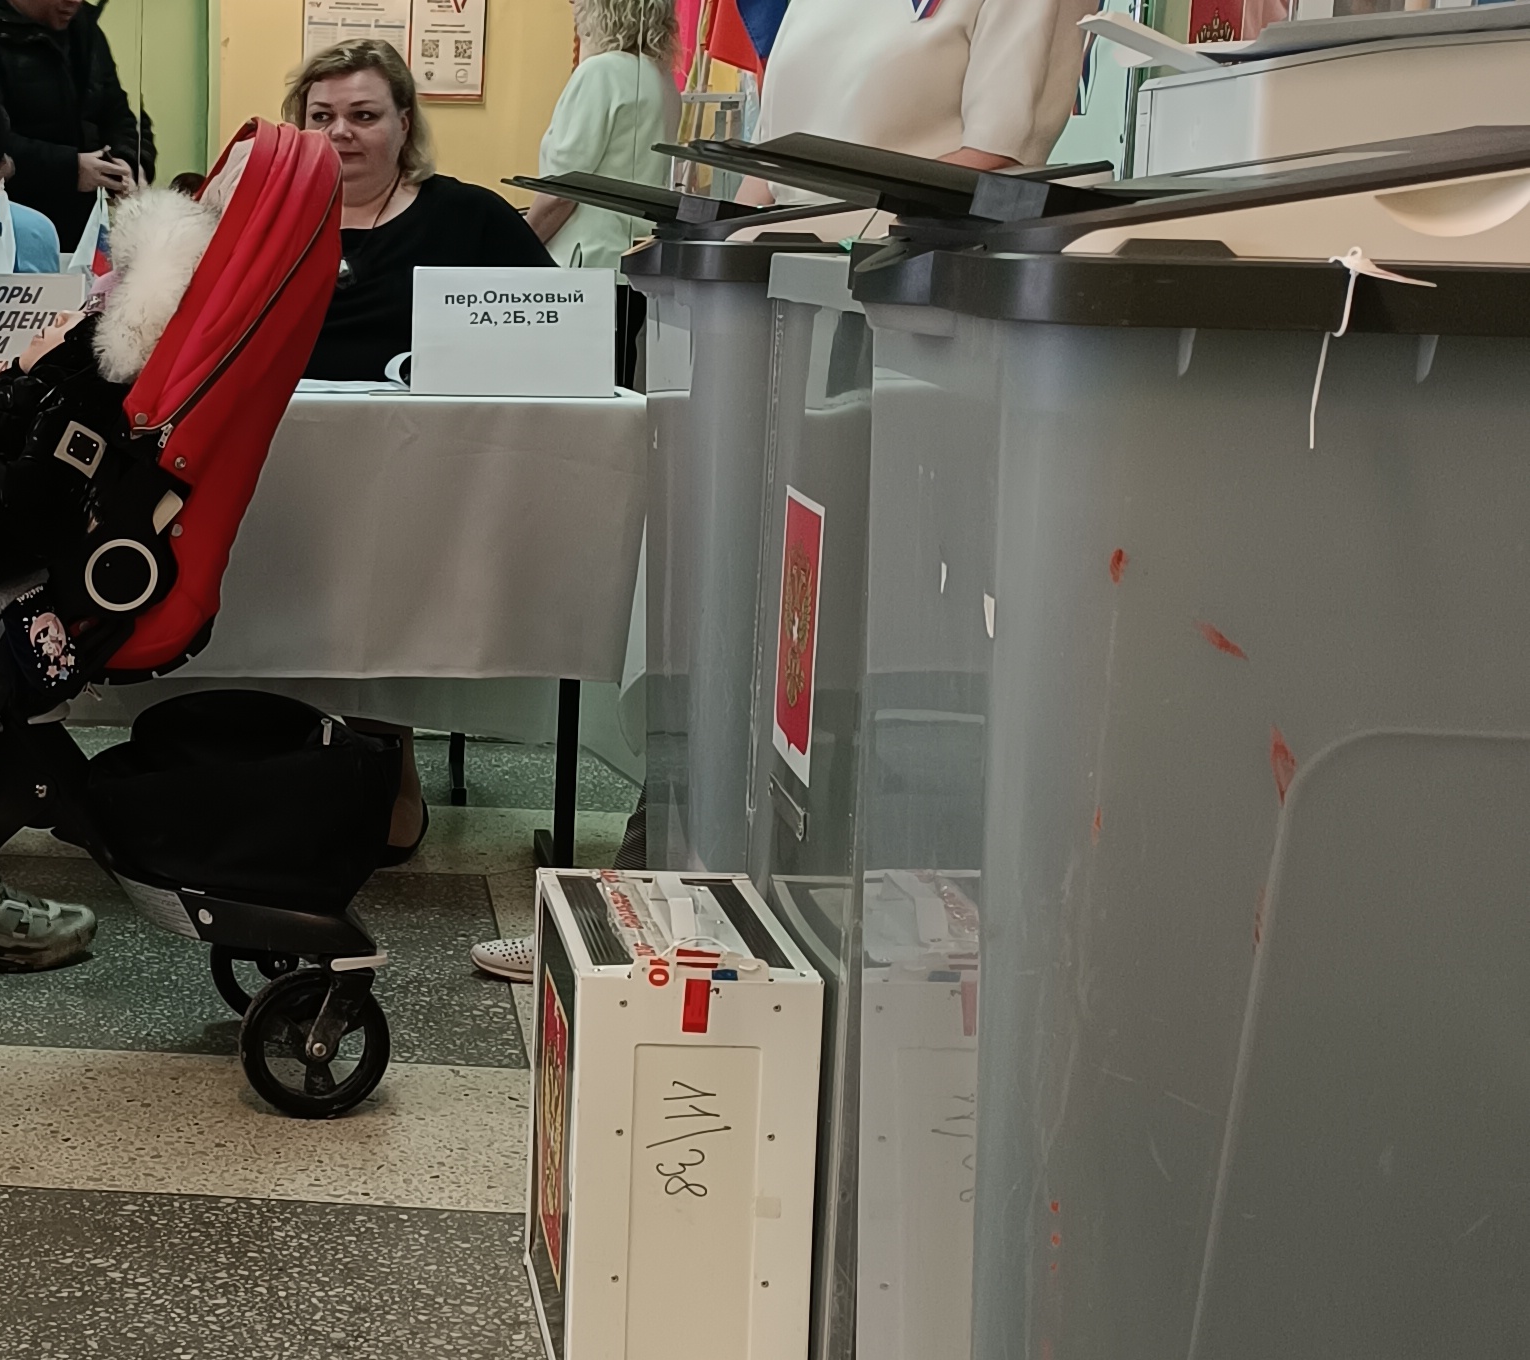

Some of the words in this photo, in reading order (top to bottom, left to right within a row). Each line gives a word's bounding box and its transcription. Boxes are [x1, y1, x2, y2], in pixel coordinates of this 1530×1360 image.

[444, 290, 584, 307] пер.Ольховый
[470, 311, 498, 326] 2А,
[502, 310, 531, 326] 2Б,
[536, 311, 559, 324] 2В
